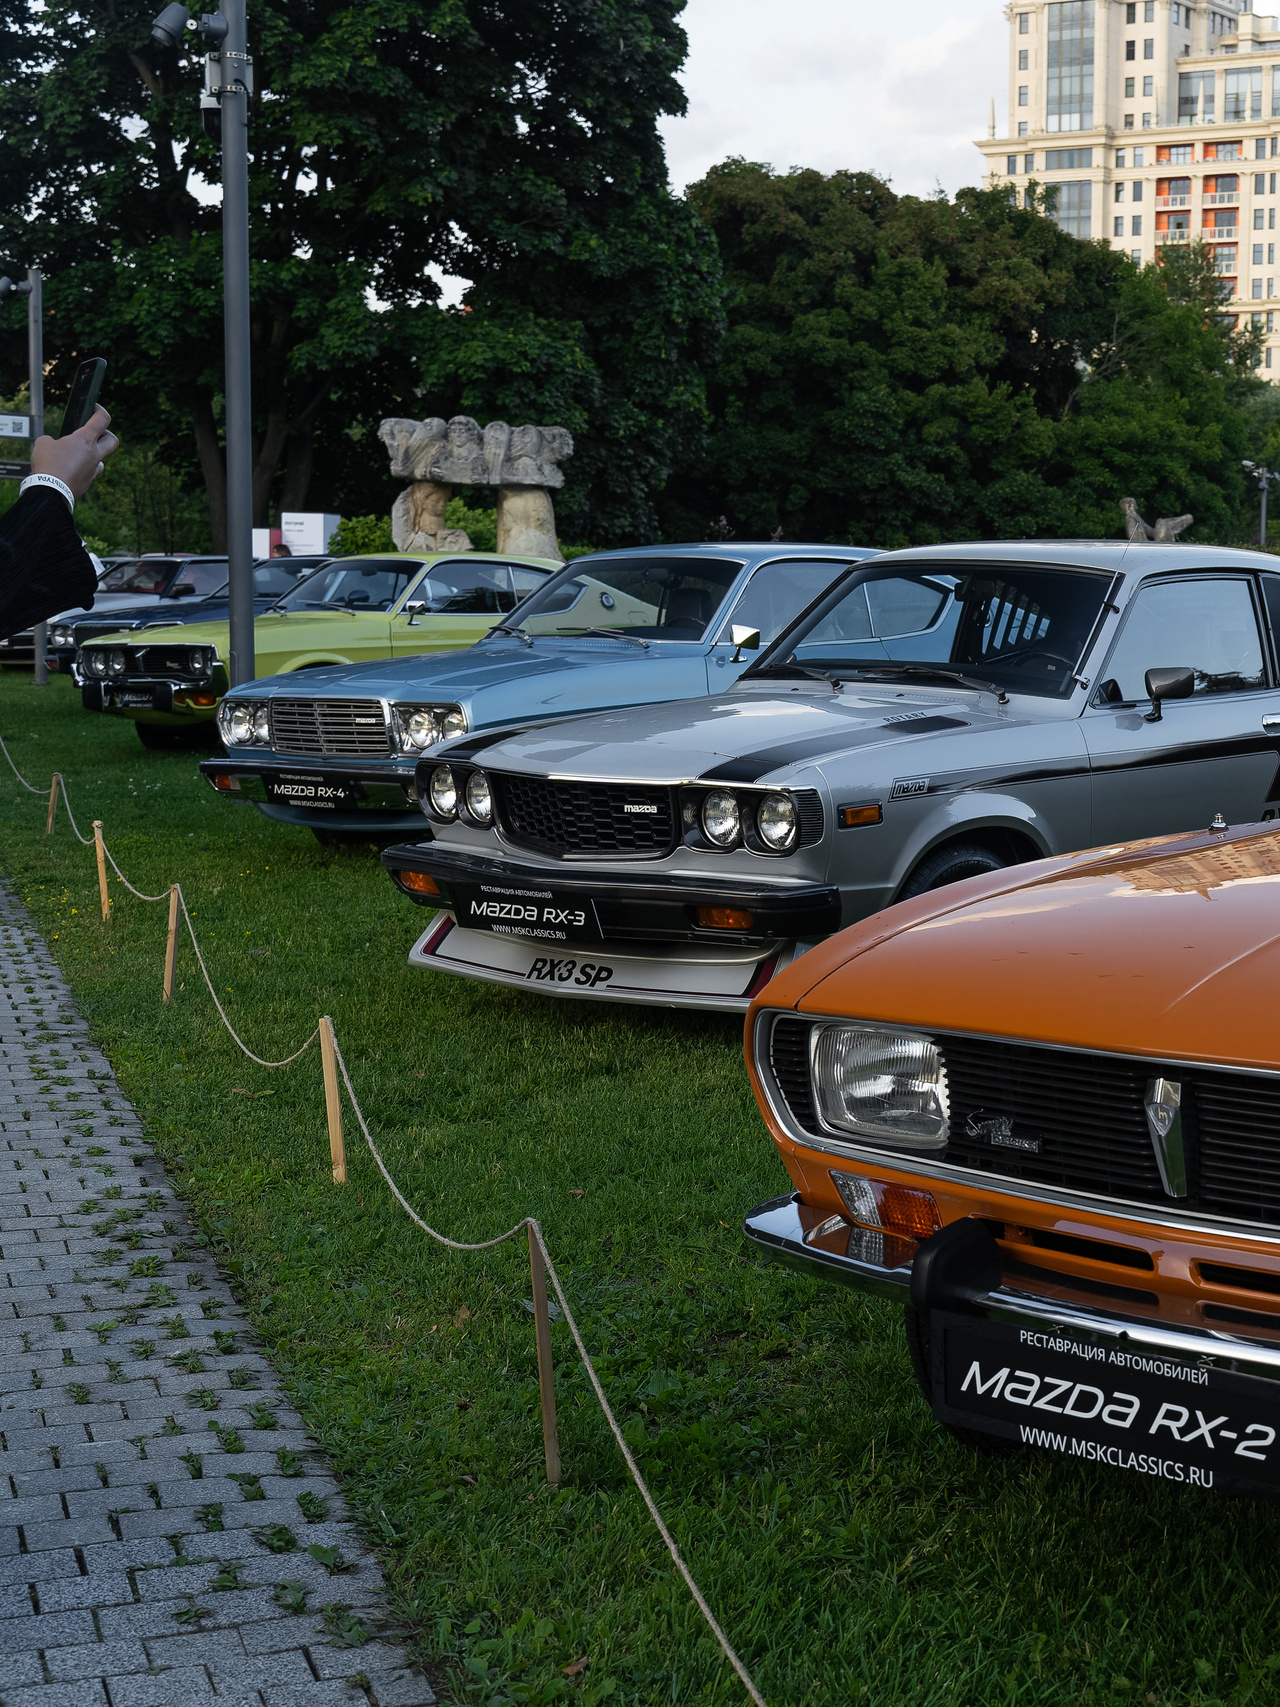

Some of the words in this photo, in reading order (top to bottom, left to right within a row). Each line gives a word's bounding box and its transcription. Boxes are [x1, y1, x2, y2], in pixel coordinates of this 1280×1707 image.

[882, 711, 927, 723] ROTARY
[317, 786, 345, 798] RX-4
[624, 804, 658, 813] mazda
[480, 885, 515, 895] РЕСТАВРАЦИЯ
[515, 889, 553, 899] АВТОМОБИЛЕЙ
[543, 908, 586, 926] RX-3
[491, 924, 567, 939] WWW.MSKCLASSICS.RU
[574, 963, 614, 988] SP
[1019, 1330, 1106, 1362] РЕСТАВРАЦИЯ
[1108, 1349, 1209, 1386] АВТОМОБИЛЕЙ
[1148, 1402, 1276, 1461] RX-2
[1019, 1424, 1214, 1489] WWW.MSKCLASSICS.RU
